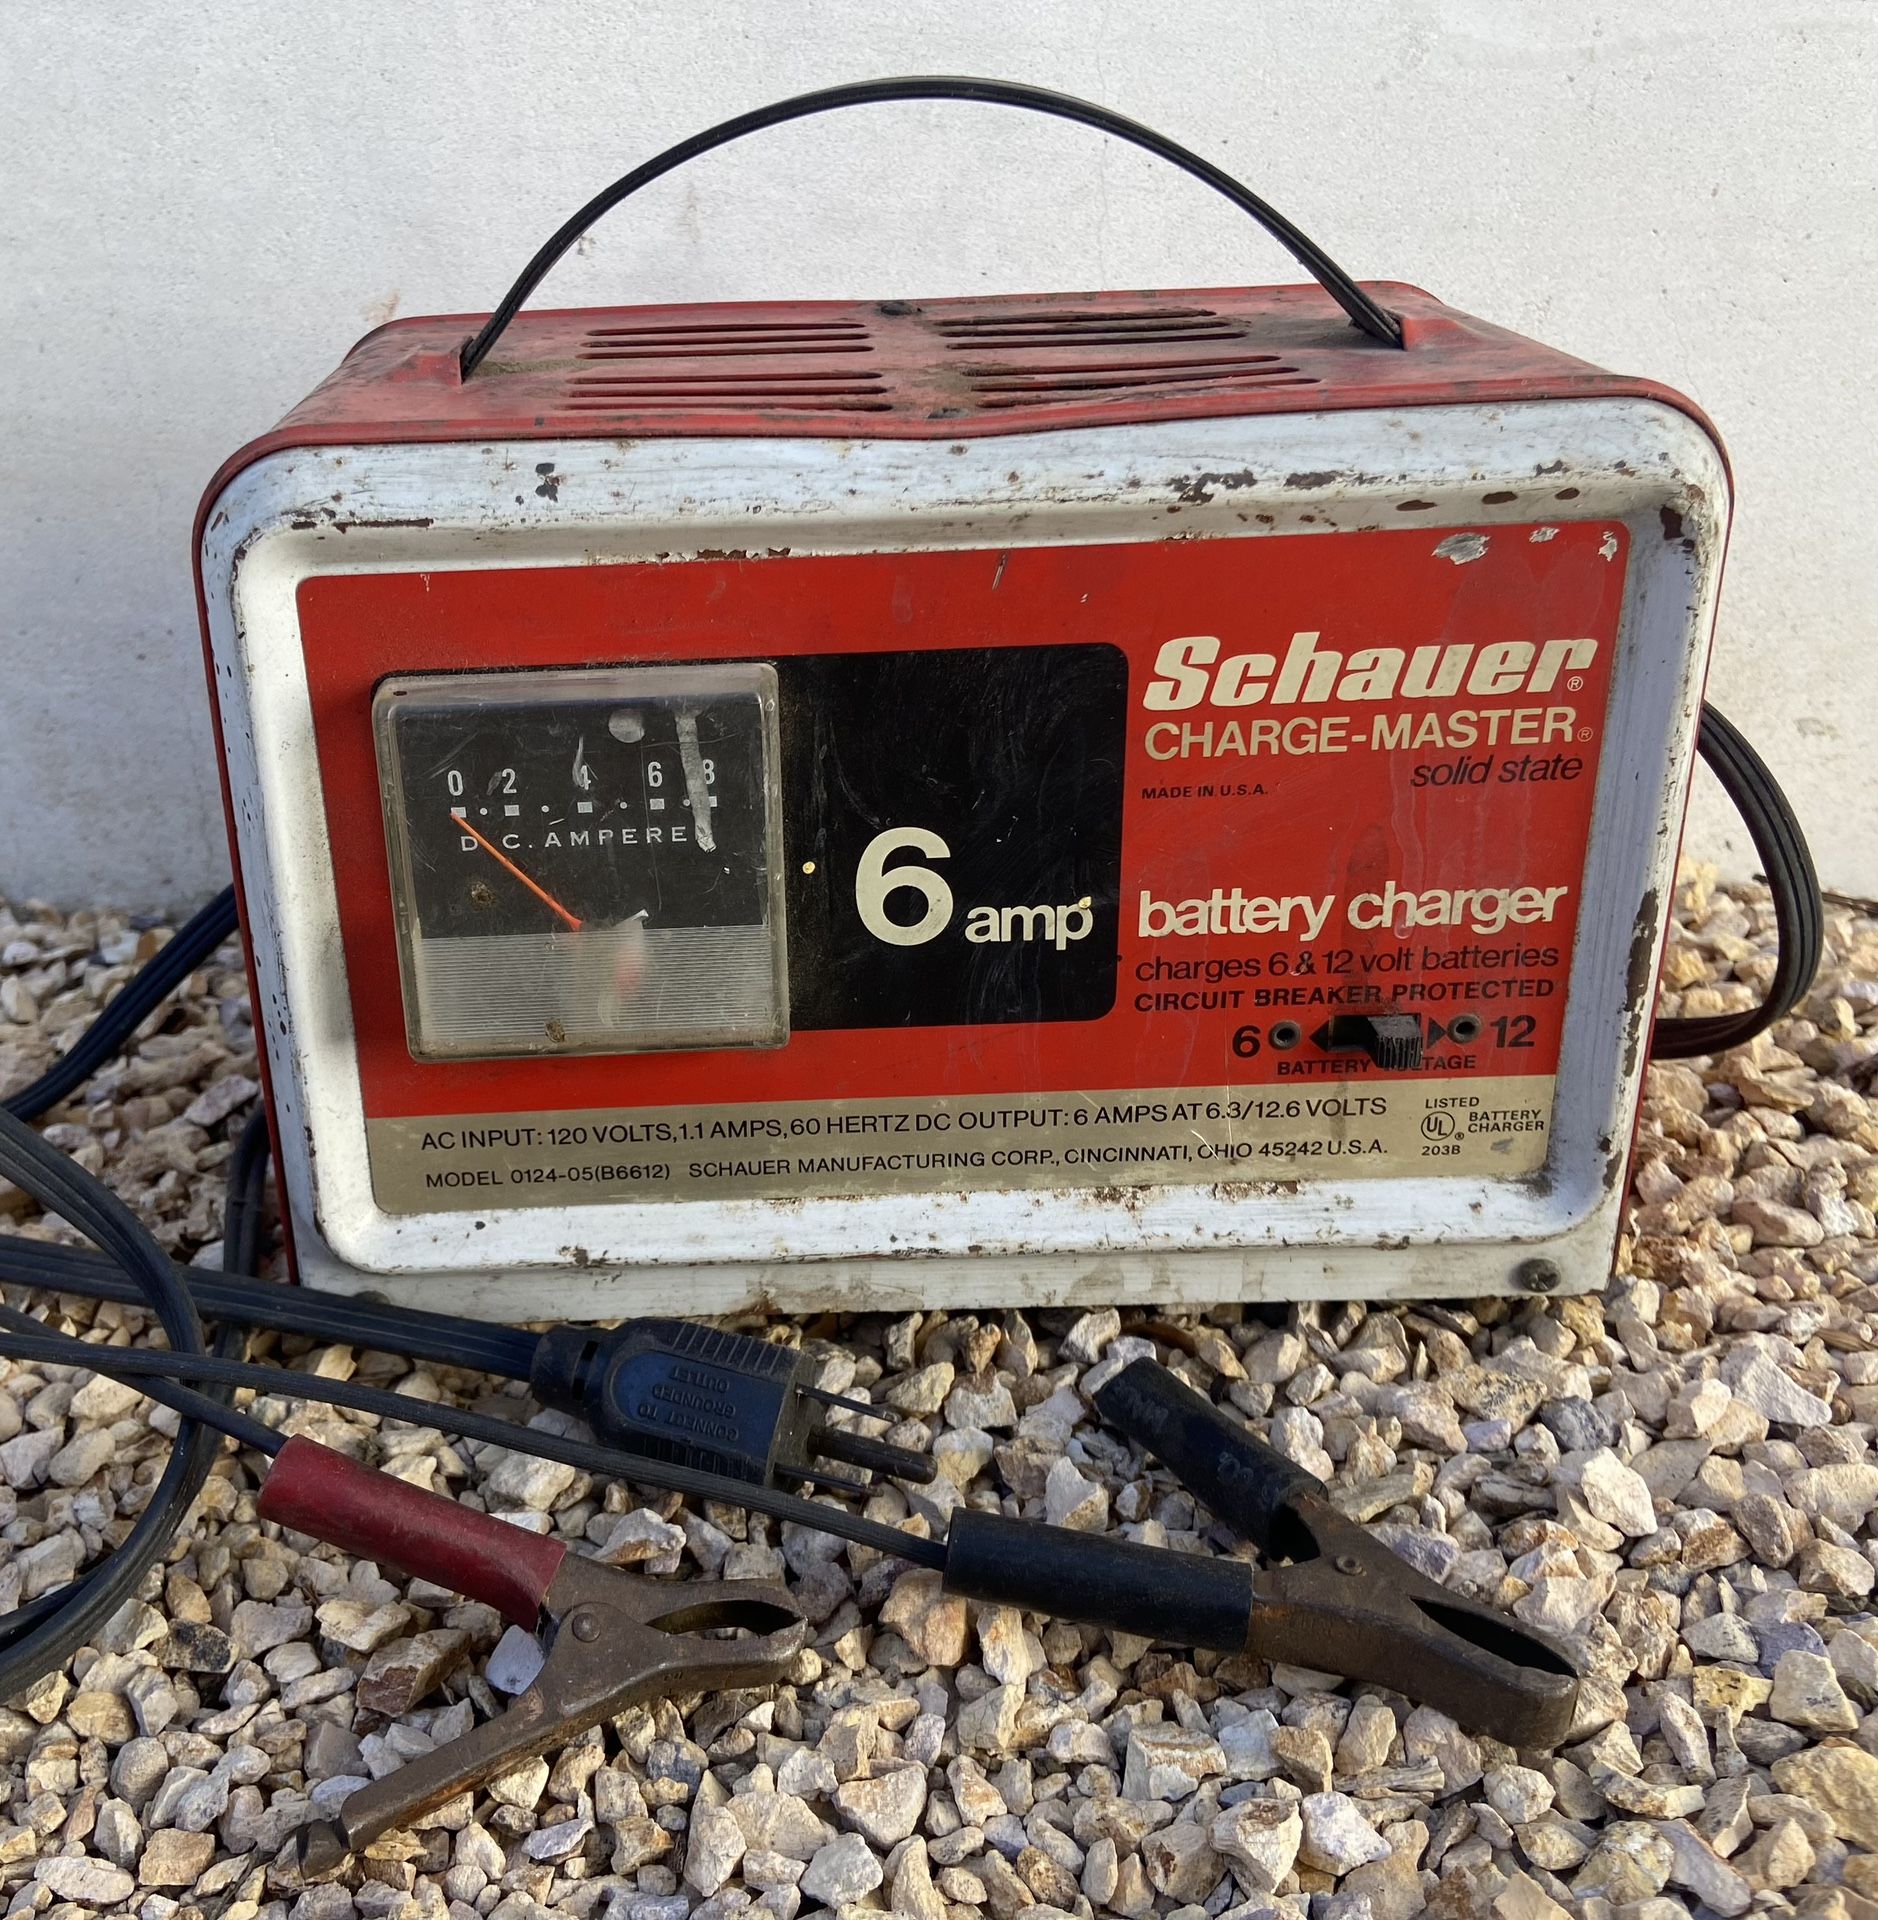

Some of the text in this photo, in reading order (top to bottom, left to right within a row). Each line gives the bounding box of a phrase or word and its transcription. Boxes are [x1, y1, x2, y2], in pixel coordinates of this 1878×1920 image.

[447, 770, 464, 796] 0
[501, 768, 517, 794] 2
[647, 761, 663, 788] 6
[702, 758, 716, 785] 8
[1410, 753, 1583, 788] solid state
[1141, 783, 1268, 800] MADE IN U.S.A.
[544, 826, 687, 848] AMPERE
[855, 826, 1094, 951] 6 amp
[1138, 881, 1568, 941] battery charger
[1135, 943, 1560, 984] charges 6 & 12 volt batteries
[1134, 979, 1555, 1012] CIRCUIT BREAKER PROTECTED
[1232, 1014, 1537, 1058] 6 12
[1277, 1055, 1477, 1076] BATTERY TAGE
[1425, 1096, 1480, 1109] LISTED
[1469, 1109, 1542, 1122] BATTERY
[421, 1131, 456, 1150] AC
[461, 1128, 543, 1149] INPUT:
[547, 1127, 588, 1146] 120
[826, 1114, 910, 1135] HERTZ
[915, 1112, 951, 1132] DC
[958, 1108, 1069, 1129] OUTPUT:
[1073, 1109, 1088, 1126] 6
[1094, 1104, 1168, 1125] AMPS
[1171, 1102, 1203, 1121] AT
[1205, 1100, 1301, 1121] 6.3/12.6
[1305, 1096, 1387, 1118] VOLTS
[1426, 1116, 1448, 1137] UL
[1468, 1120, 1545, 1133] CHARGER
[426, 1139, 1388, 1188] MODEL 0124-05(B6612) SCHAUER MANUFACTURING CORP., CINCINNATI, OHIO 45242 U.S.A.
[1421, 1144, 1461, 1156] 203B
[668, 1365, 730, 1394] OUTLET
[652, 1383, 737, 1419] GROUNDED
[637, 1401, 740, 1441] CONNECT TO
